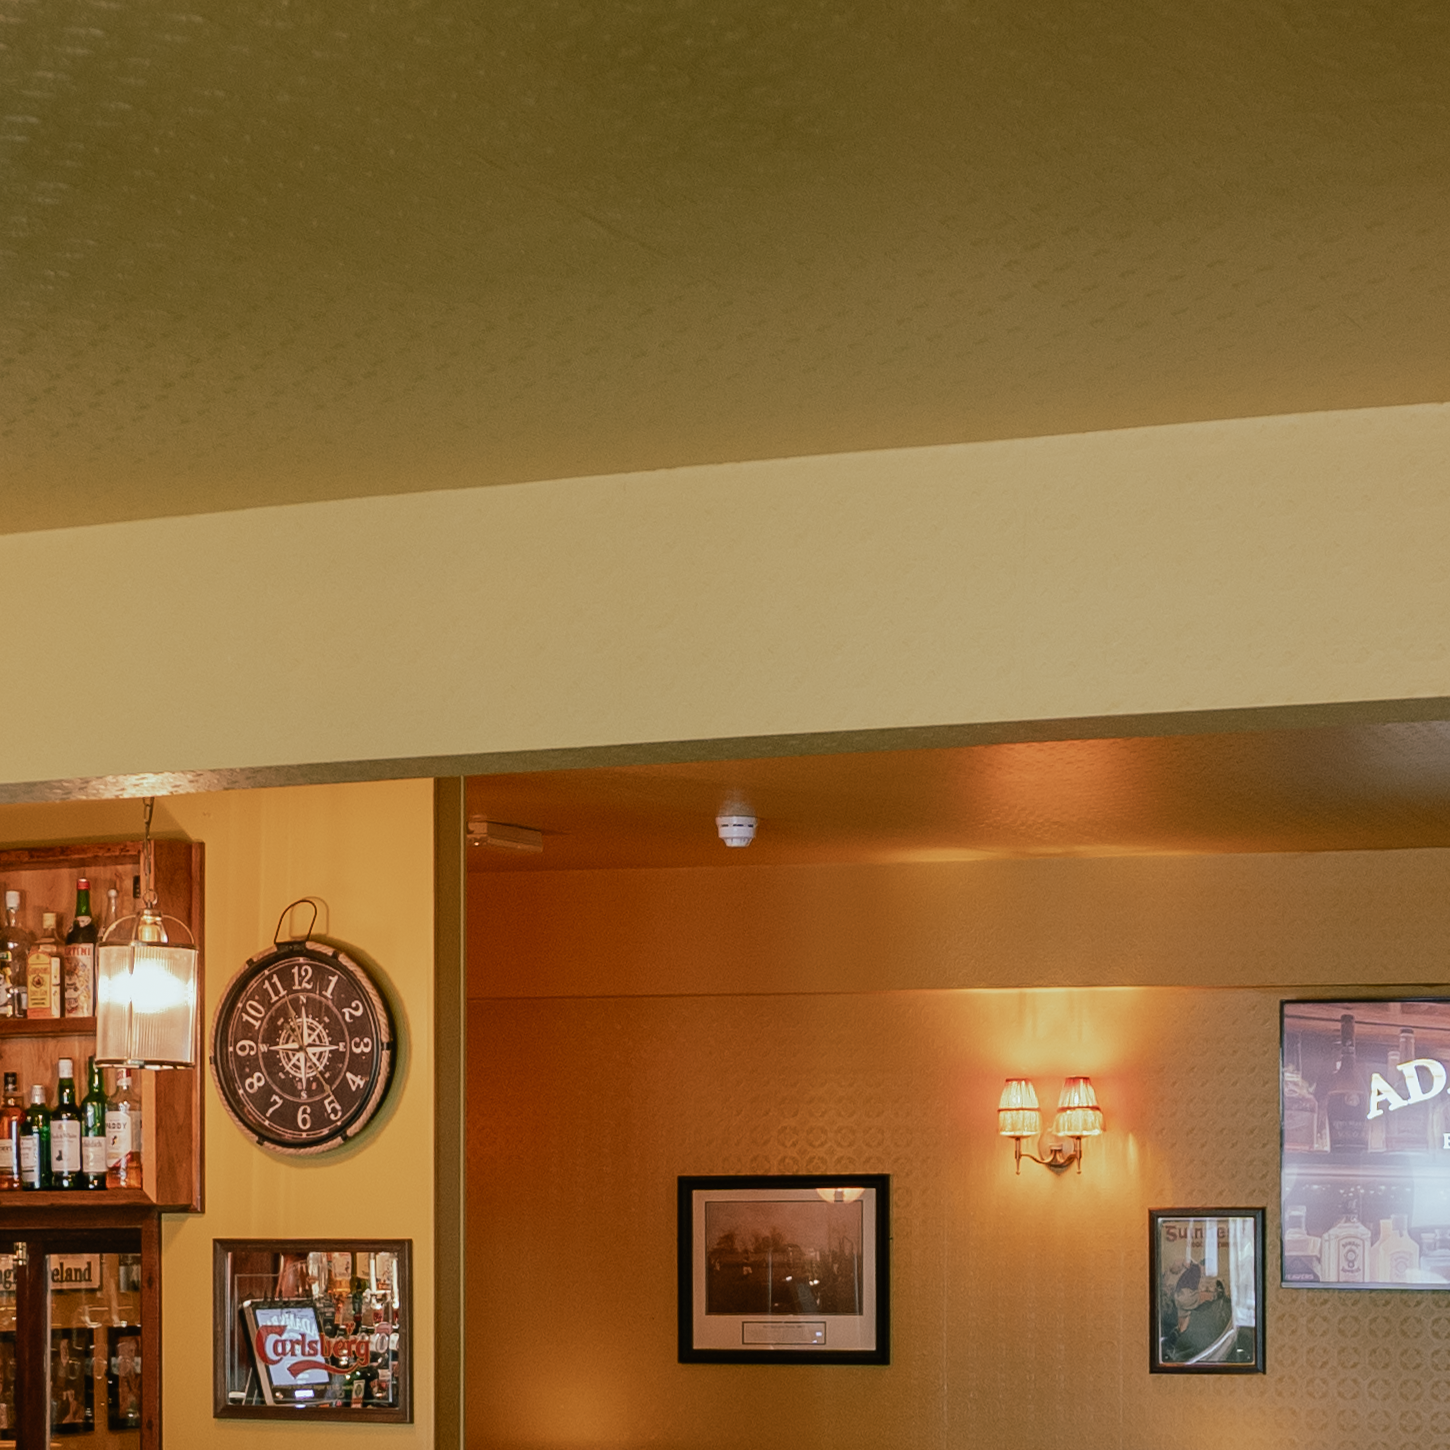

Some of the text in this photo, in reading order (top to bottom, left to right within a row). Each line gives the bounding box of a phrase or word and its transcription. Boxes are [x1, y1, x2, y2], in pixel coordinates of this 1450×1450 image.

[263, 973, 288, 1003] 11
[291, 964, 313, 990] 12
[322, 974, 339, 1000] 1
[242, 1000, 266, 1030] 10
[342, 1000, 364, 1023] 2
[235, 1038, 257, 1057] 9
[351, 1037, 372, 1054] 3
[244, 1072, 266, 1093] 8
[345, 1071, 365, 1091] 4
[265, 1094, 284, 1117] 7
[297, 1105, 311, 1130] 6
[323, 1095, 342, 1120] 5
[255, 1325, 371, 1370] Carlsberg
